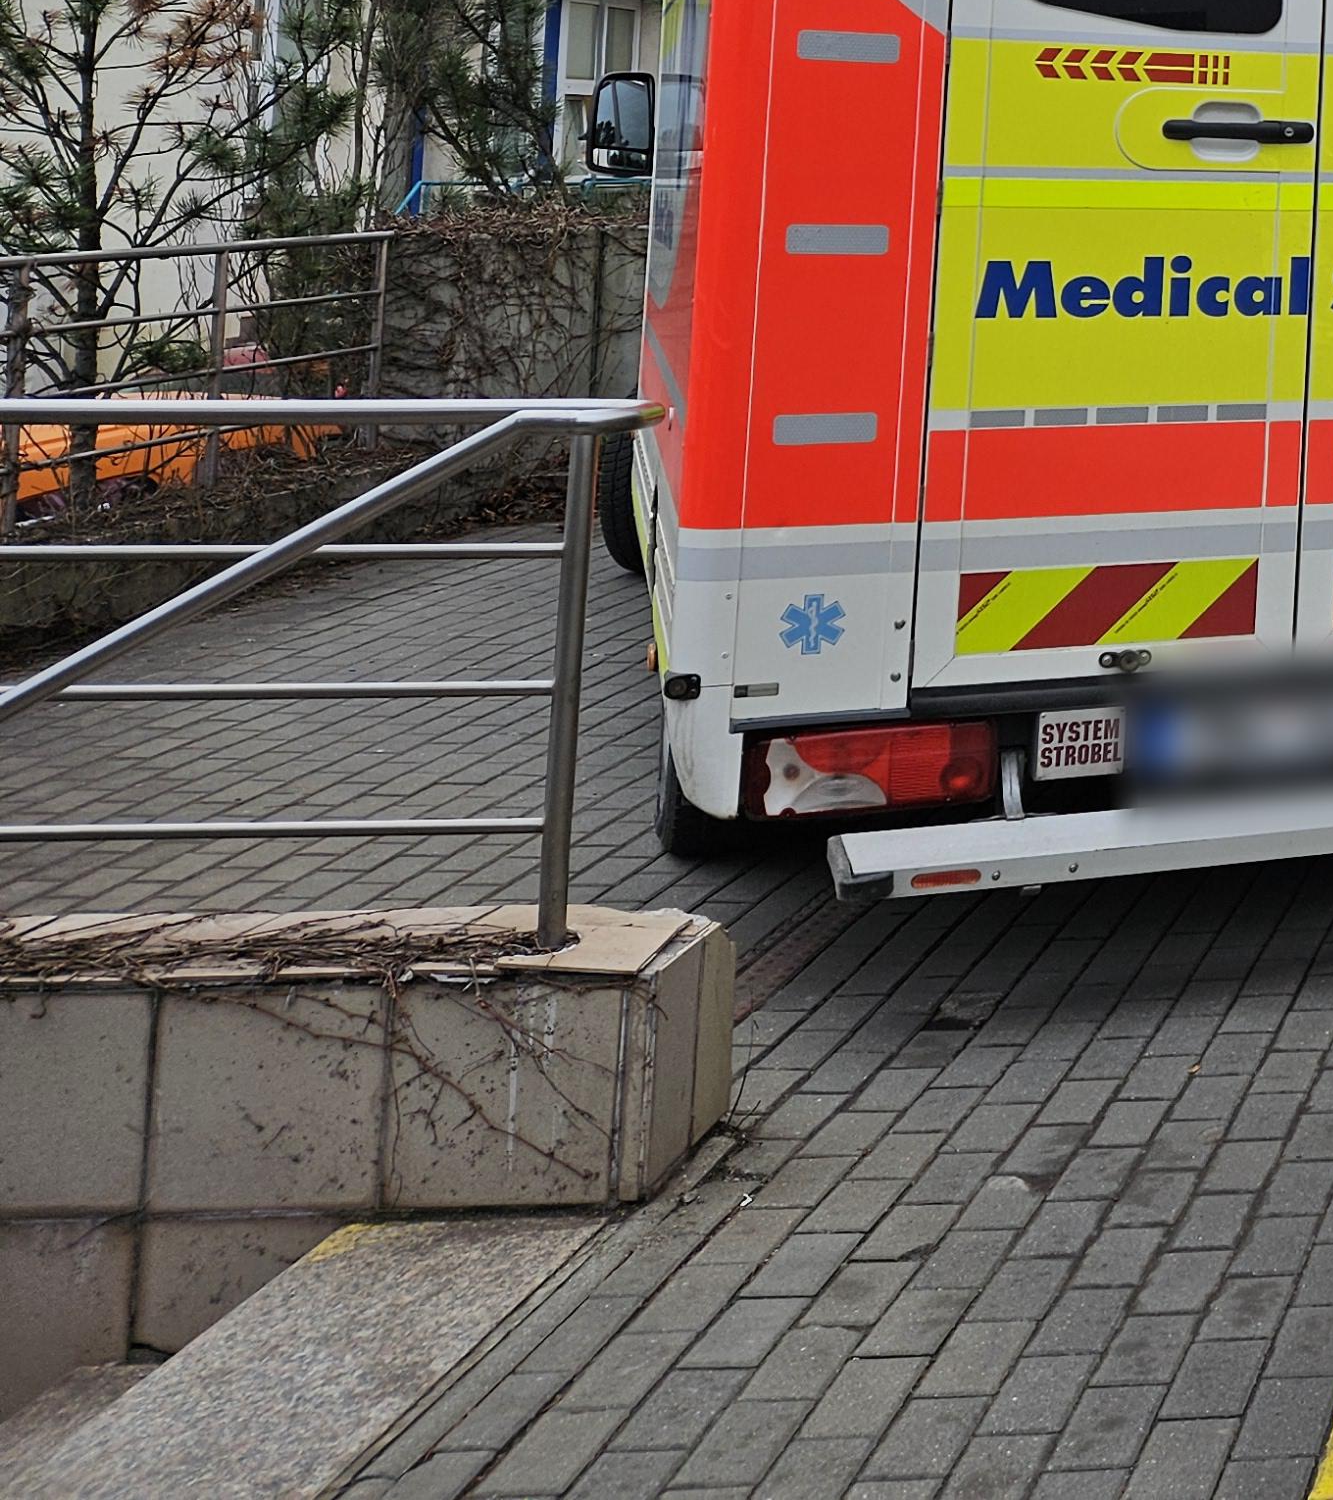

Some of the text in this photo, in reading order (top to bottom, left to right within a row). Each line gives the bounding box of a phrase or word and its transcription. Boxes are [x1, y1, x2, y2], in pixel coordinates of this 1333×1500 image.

[974, 256, 1310, 319] Medical
[1041, 718, 1120, 745] SYSTEM
[1040, 741, 1121, 768] STROBEL
